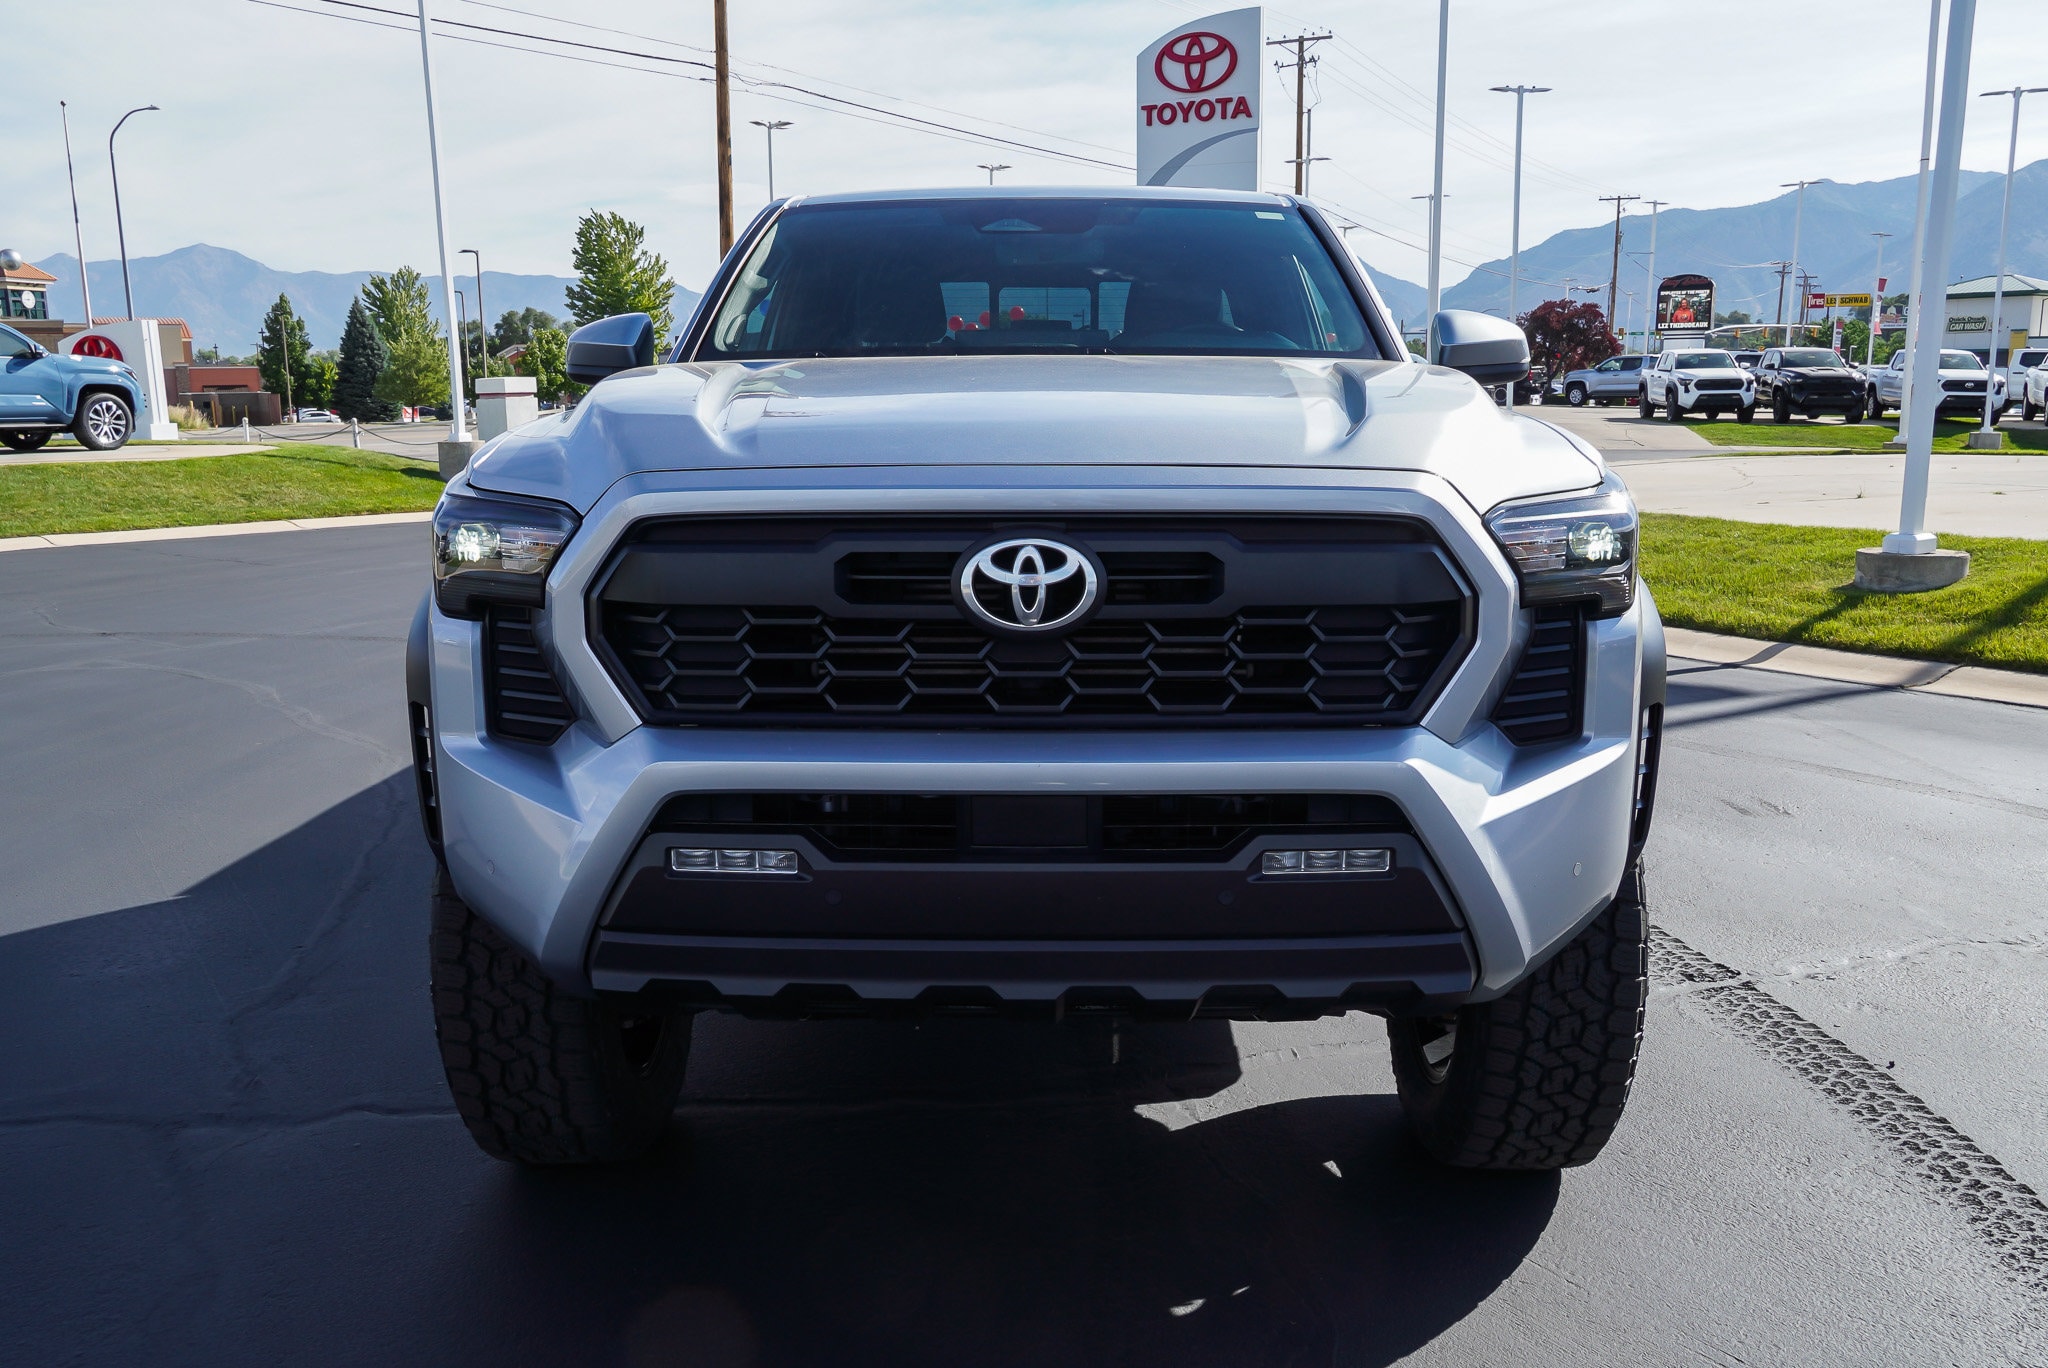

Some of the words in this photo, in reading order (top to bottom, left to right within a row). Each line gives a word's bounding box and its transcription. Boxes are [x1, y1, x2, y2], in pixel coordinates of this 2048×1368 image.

[1141, 96, 1252, 126] TOYOTA
[1807, 294, 1824, 307] Tires
[1840, 296, 1868, 304] SCHWAB
[1965, 322, 1985, 330] WASH
